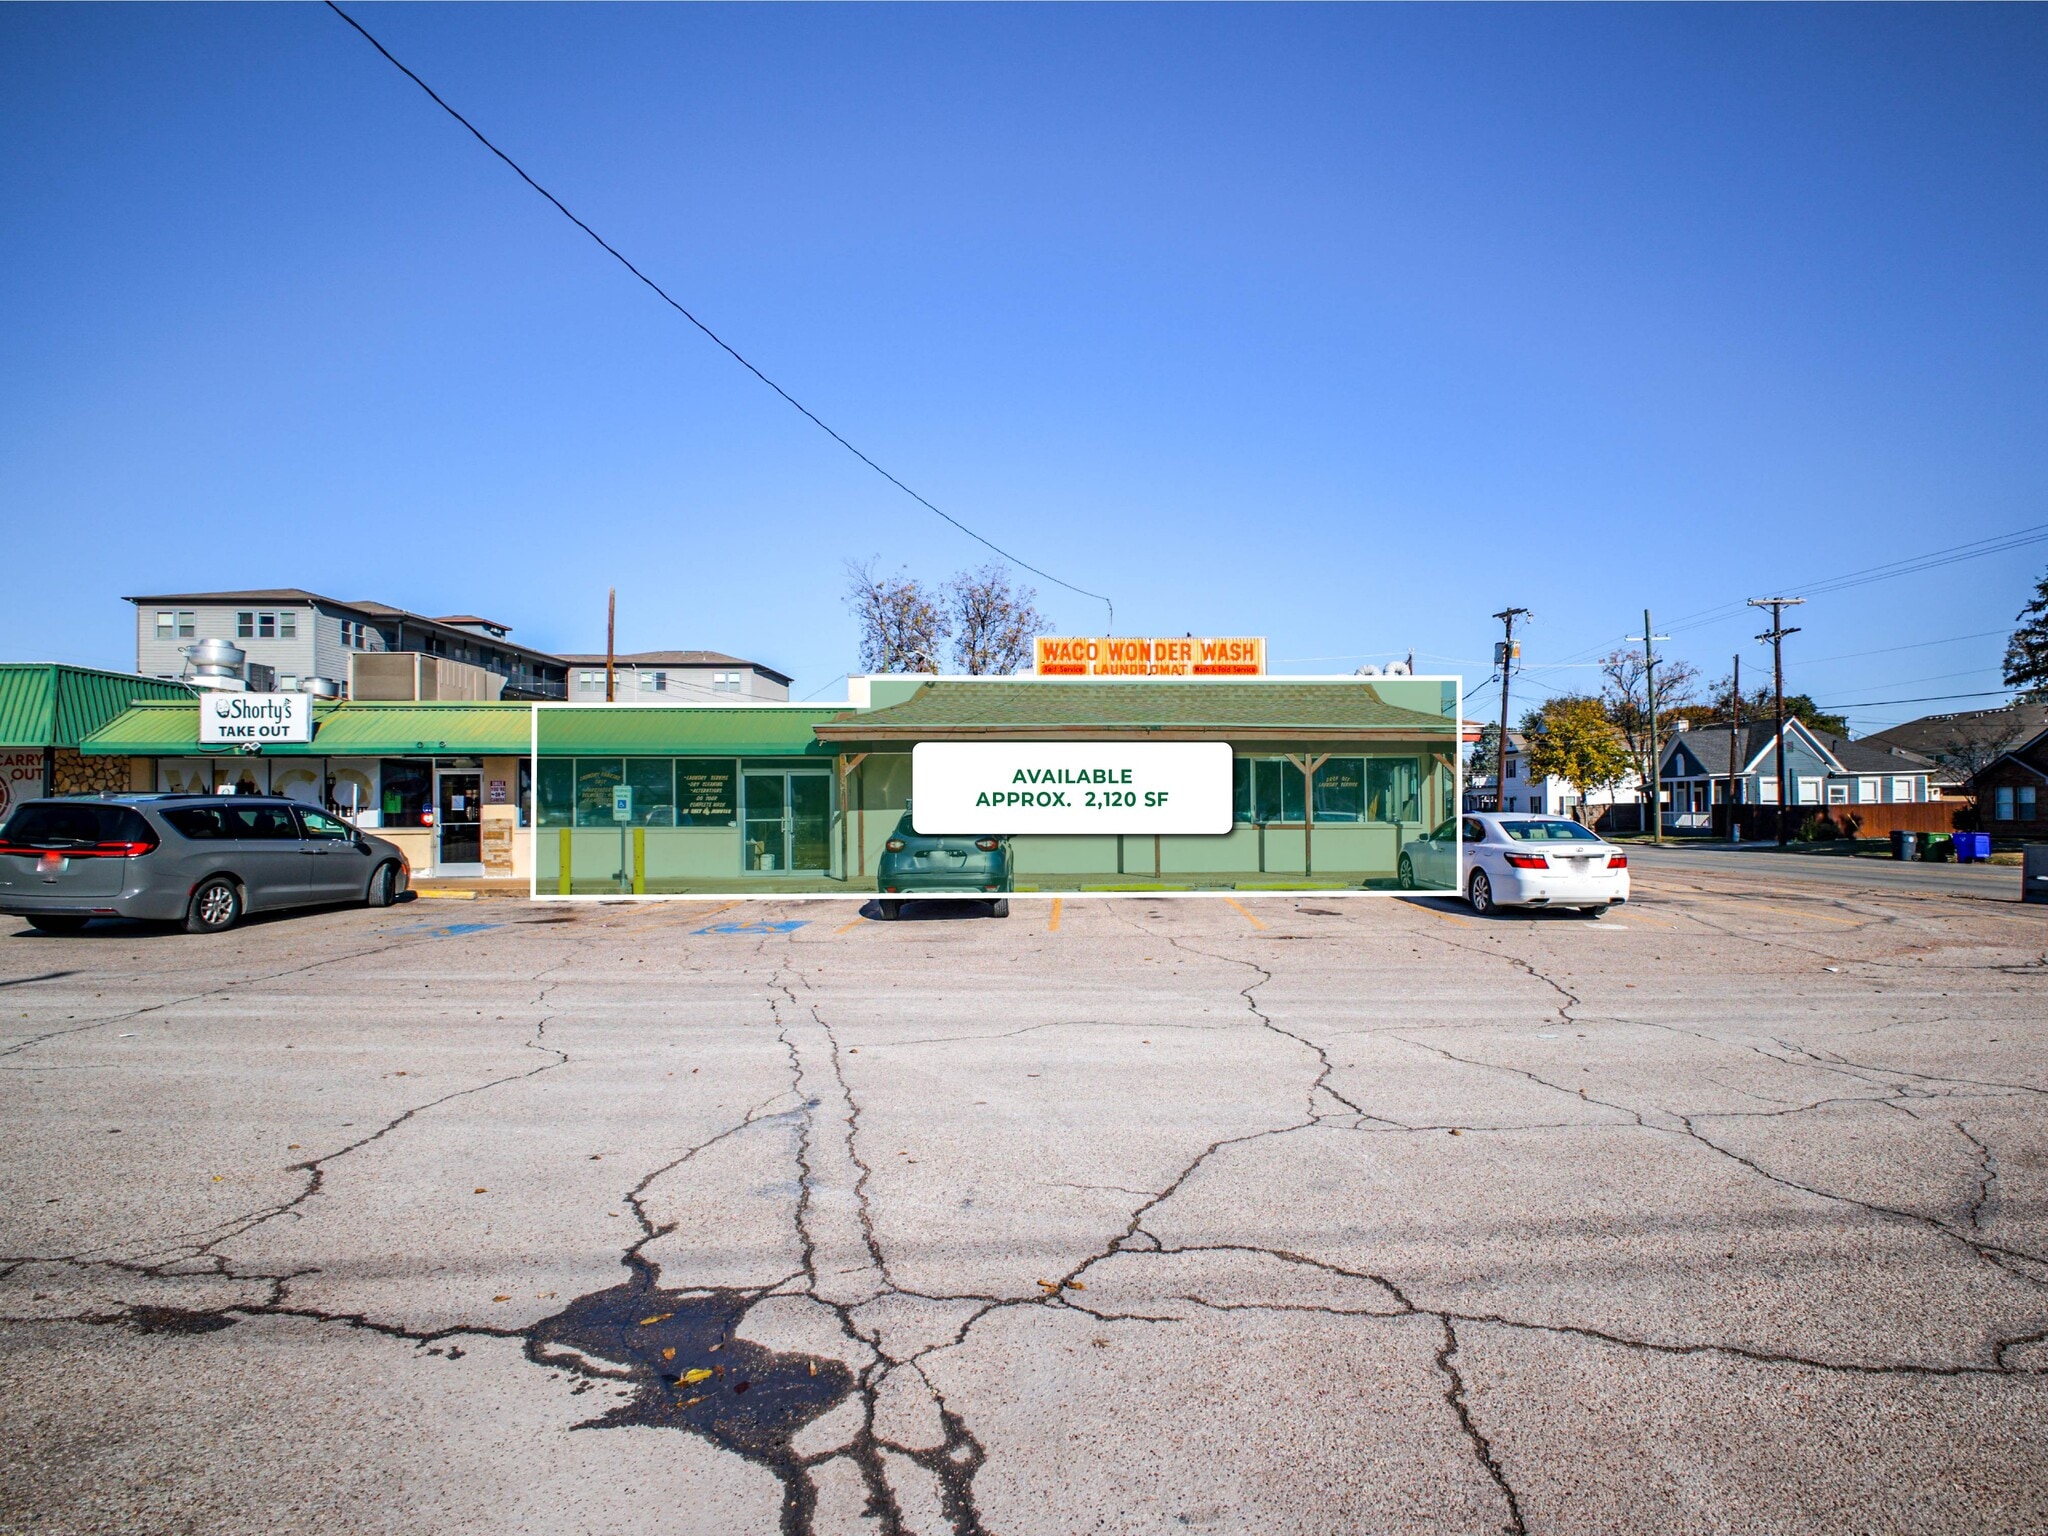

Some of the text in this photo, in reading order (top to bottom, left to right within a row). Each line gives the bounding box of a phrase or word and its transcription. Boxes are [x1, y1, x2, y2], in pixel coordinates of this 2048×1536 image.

[1043, 643, 1254, 661] WACO WONDER WASH
[1060, 665, 1083, 673] Service
[1093, 664, 1187, 675] LAUNDROMAT
[1233, 665, 1256, 673] Service
[231, 698, 292, 724] Shorty's
[219, 726, 290, 736] TAKE OUT
[11, 768, 44, 780] OUT
